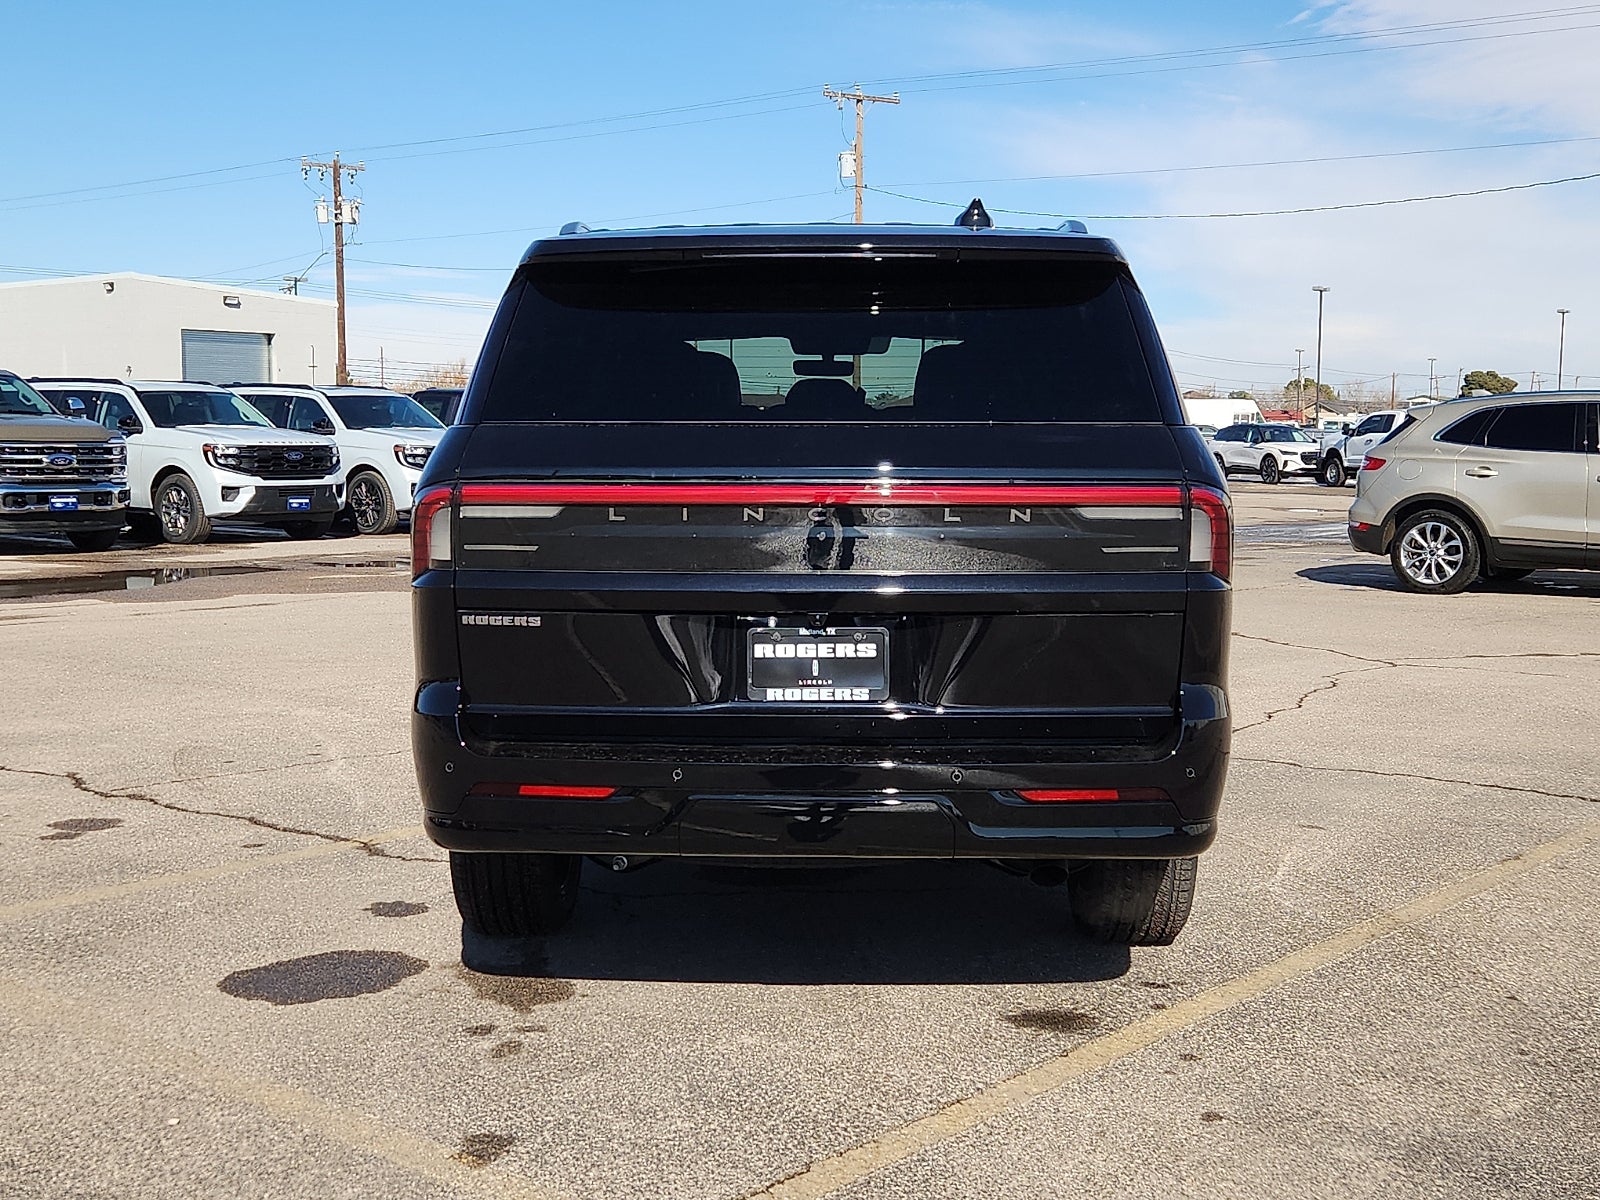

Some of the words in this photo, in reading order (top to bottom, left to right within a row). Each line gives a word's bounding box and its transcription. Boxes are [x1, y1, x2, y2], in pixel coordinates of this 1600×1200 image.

[607, 507, 1031, 522] LINCOLN
[462, 615, 541, 627] ROGERS
[826, 627, 836, 636] TX
[753, 643, 877, 658] ROGERS
[766, 688, 870, 701] ROGERS
